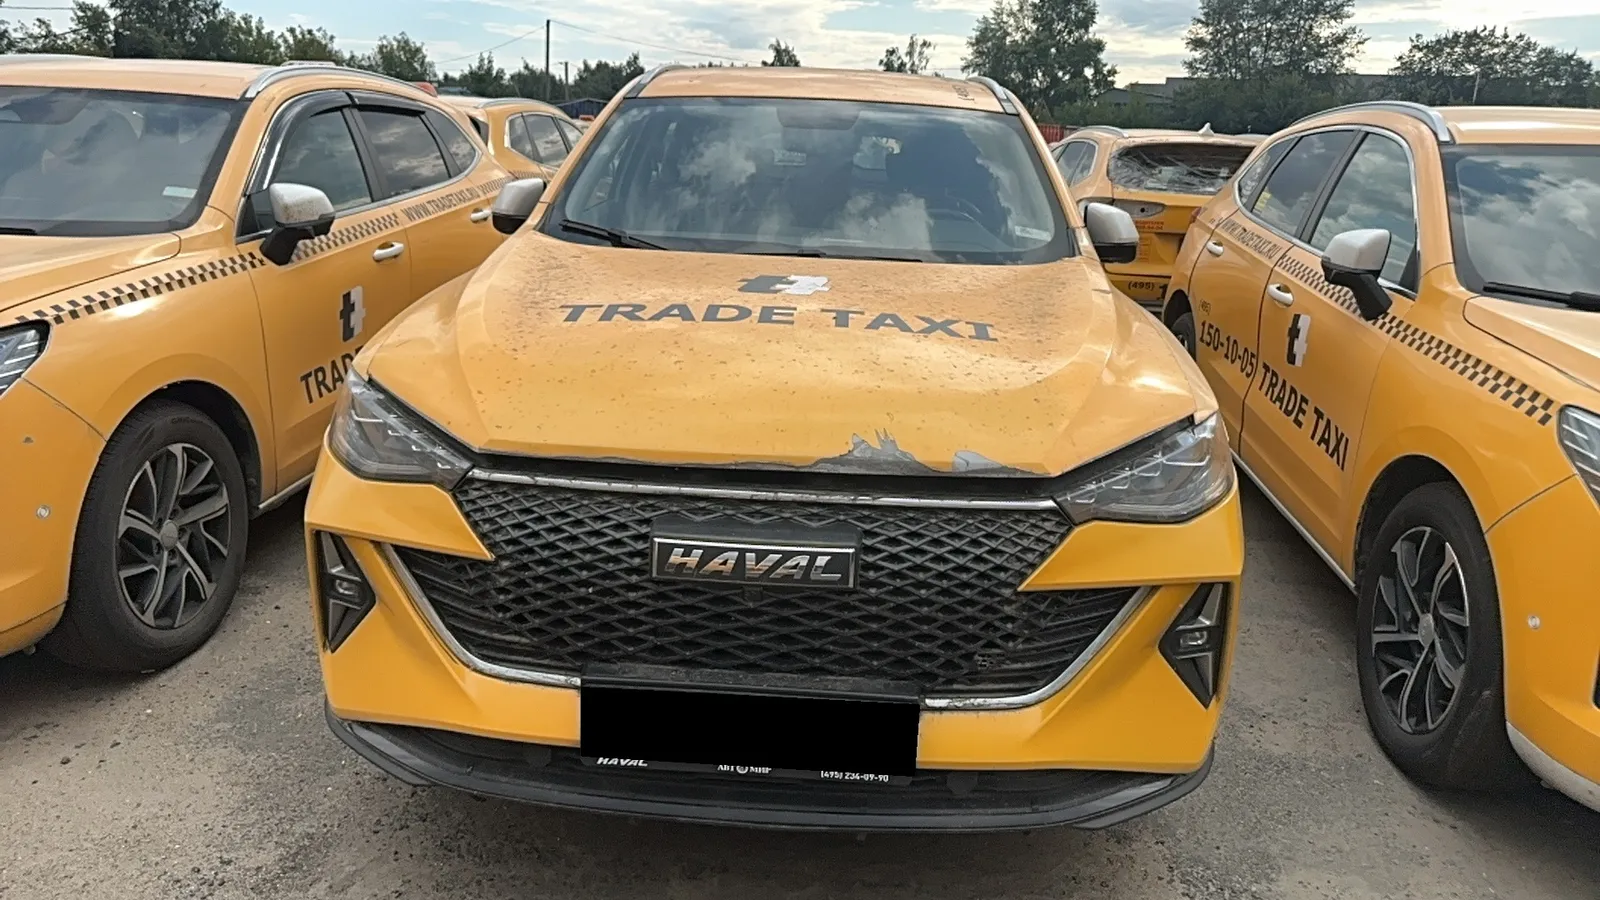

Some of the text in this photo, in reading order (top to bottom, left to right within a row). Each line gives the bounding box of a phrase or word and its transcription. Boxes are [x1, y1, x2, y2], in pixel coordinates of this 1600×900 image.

[401, 186, 480, 222] WWW.TRADETAXI.RU
[559, 303, 999, 341] TRADE TAXI
[1200, 320, 1256, 378] 150-10-05
[300, 344, 364, 404] TRAD
[1258, 361, 1350, 472] TRADE TAXI
[664, 547, 842, 581] HAVAL
[596, 757, 648, 767] HAVAL
